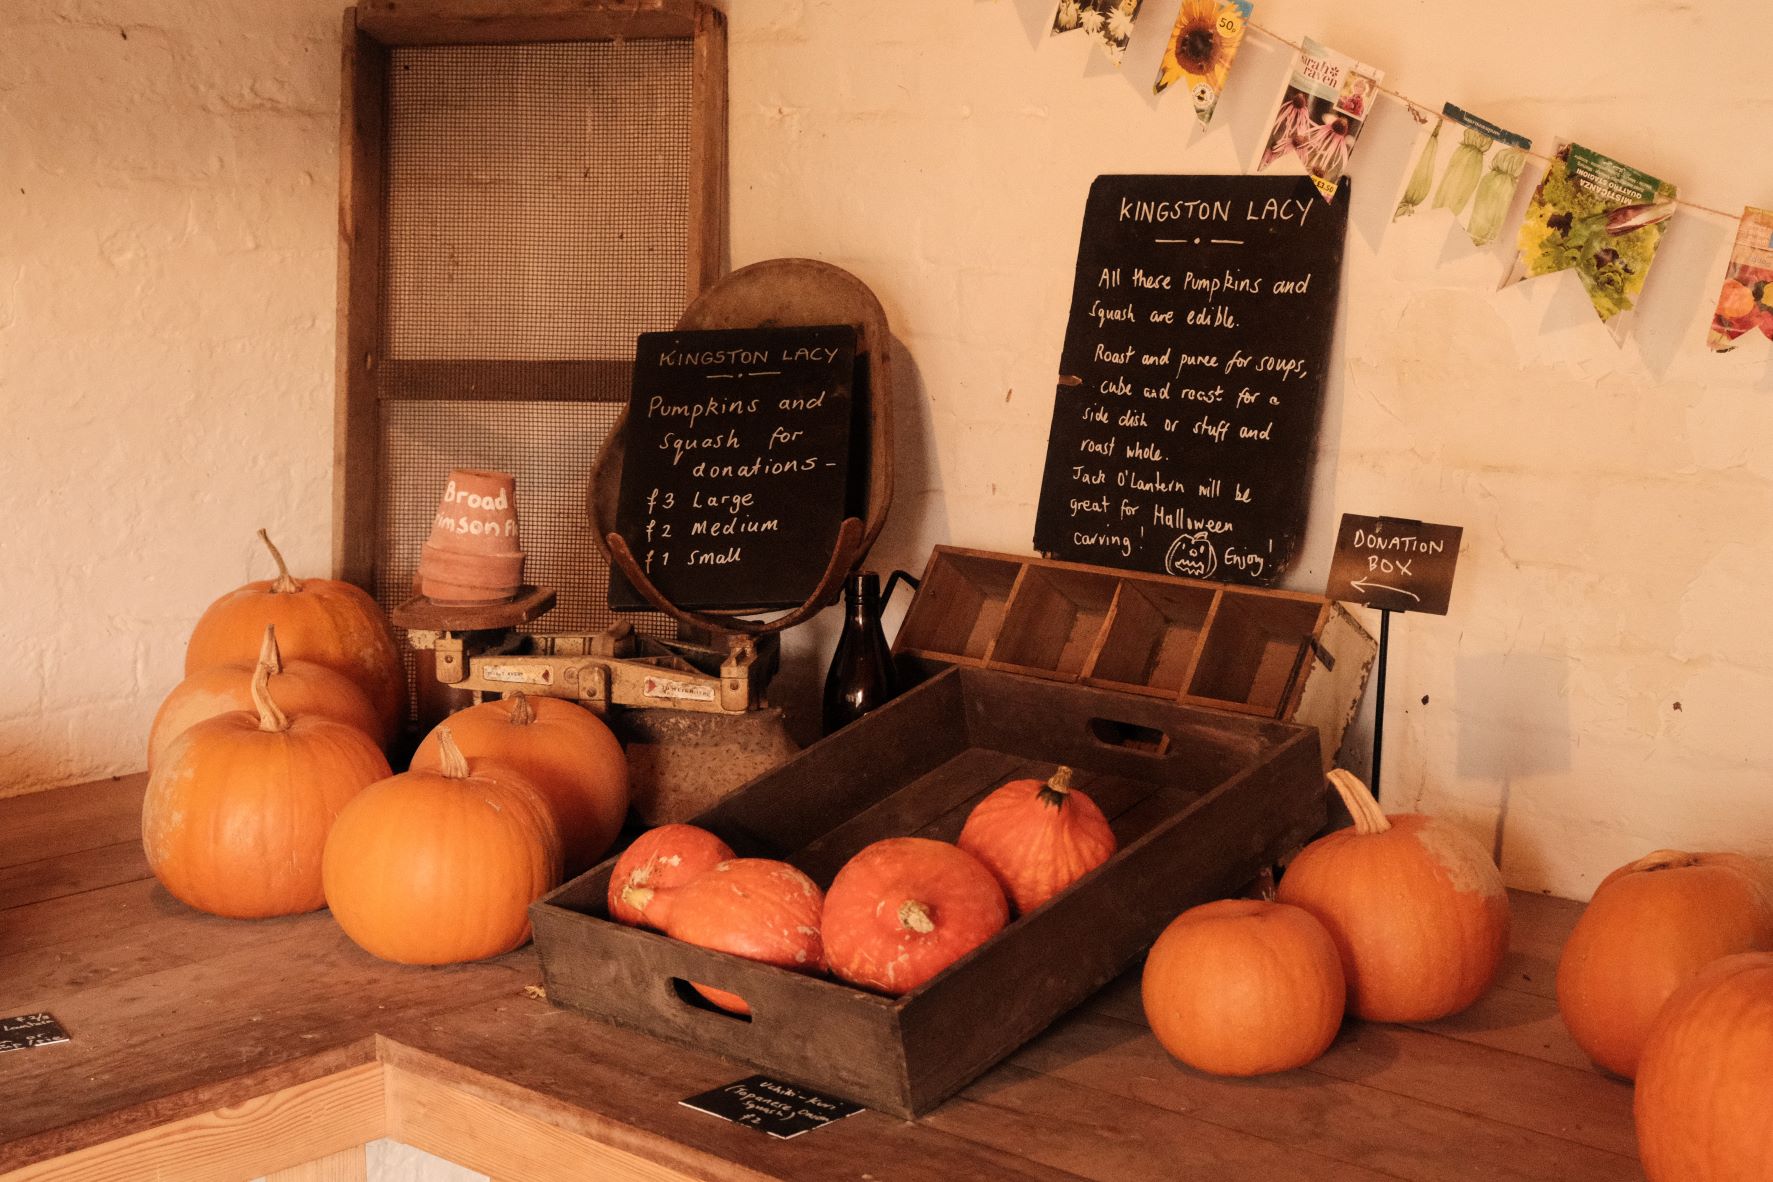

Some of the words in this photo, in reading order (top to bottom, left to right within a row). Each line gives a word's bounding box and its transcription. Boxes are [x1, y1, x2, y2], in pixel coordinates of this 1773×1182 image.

[1316, 178, 1334, 193] £3.50
[1576, 168, 1608, 185] STAGIONI
[1580, 179, 1632, 205] MISTICANZA
[1608, 183, 1642, 199] QUATTRO
[1119, 197, 1231, 223] KINGSTON
[1247, 197, 1314, 226] LACY
[1098, 268, 1120, 289] All
[1132, 268, 1171, 290] these
[1184, 268, 1263, 302] Pumpkins
[1273, 273, 1311, 294] and
[1089, 300, 1136, 328] Squash
[1150, 309, 1173, 324] are
[1187, 305, 1239, 329] edible.
[659, 349, 768, 366] KINGSTON
[782, 347, 839, 364] LACY
[1094, 343, 1135, 365] Roast
[1142, 348, 1171, 366] and
[1176, 352, 1218, 379] puree
[1225, 350, 1252, 374] for
[1256, 354, 1307, 381] soups,
[1100, 376, 1132, 396] cube
[1143, 382, 1170, 399] and
[1181, 385, 1223, 403] roast
[1236, 388, 1260, 408] for
[1269, 395, 1280, 406] a
[648, 395, 759, 428] Pumpkins
[779, 390, 825, 410] and
[1082, 402, 1109, 424] side
[1118, 410, 1148, 427] dish
[1165, 419, 1180, 432] or
[1193, 416, 1230, 442] stuff
[1239, 422, 1273, 441] and
[659, 429, 740, 465] Squash
[768, 427, 803, 450] for
[1081, 437, 1115, 457] roast
[1126, 442, 1169, 462] whole.
[444, 481, 508, 510] Broad
[1072, 466, 1106, 484] Jack
[1118, 470, 1185, 493] O'Lantern
[1199, 478, 1220, 498] will
[1234, 483, 1252, 503] be
[692, 491, 754, 514] Large
[1070, 496, 1110, 517] great
[1120, 499, 1139, 520] for
[1154, 507, 1233, 533] Halloween
[691, 514, 778, 536] Medium
[1354, 529, 1444, 554] DONATION
[688, 548, 741, 565] Small
[1368, 556, 1412, 576] BOX
